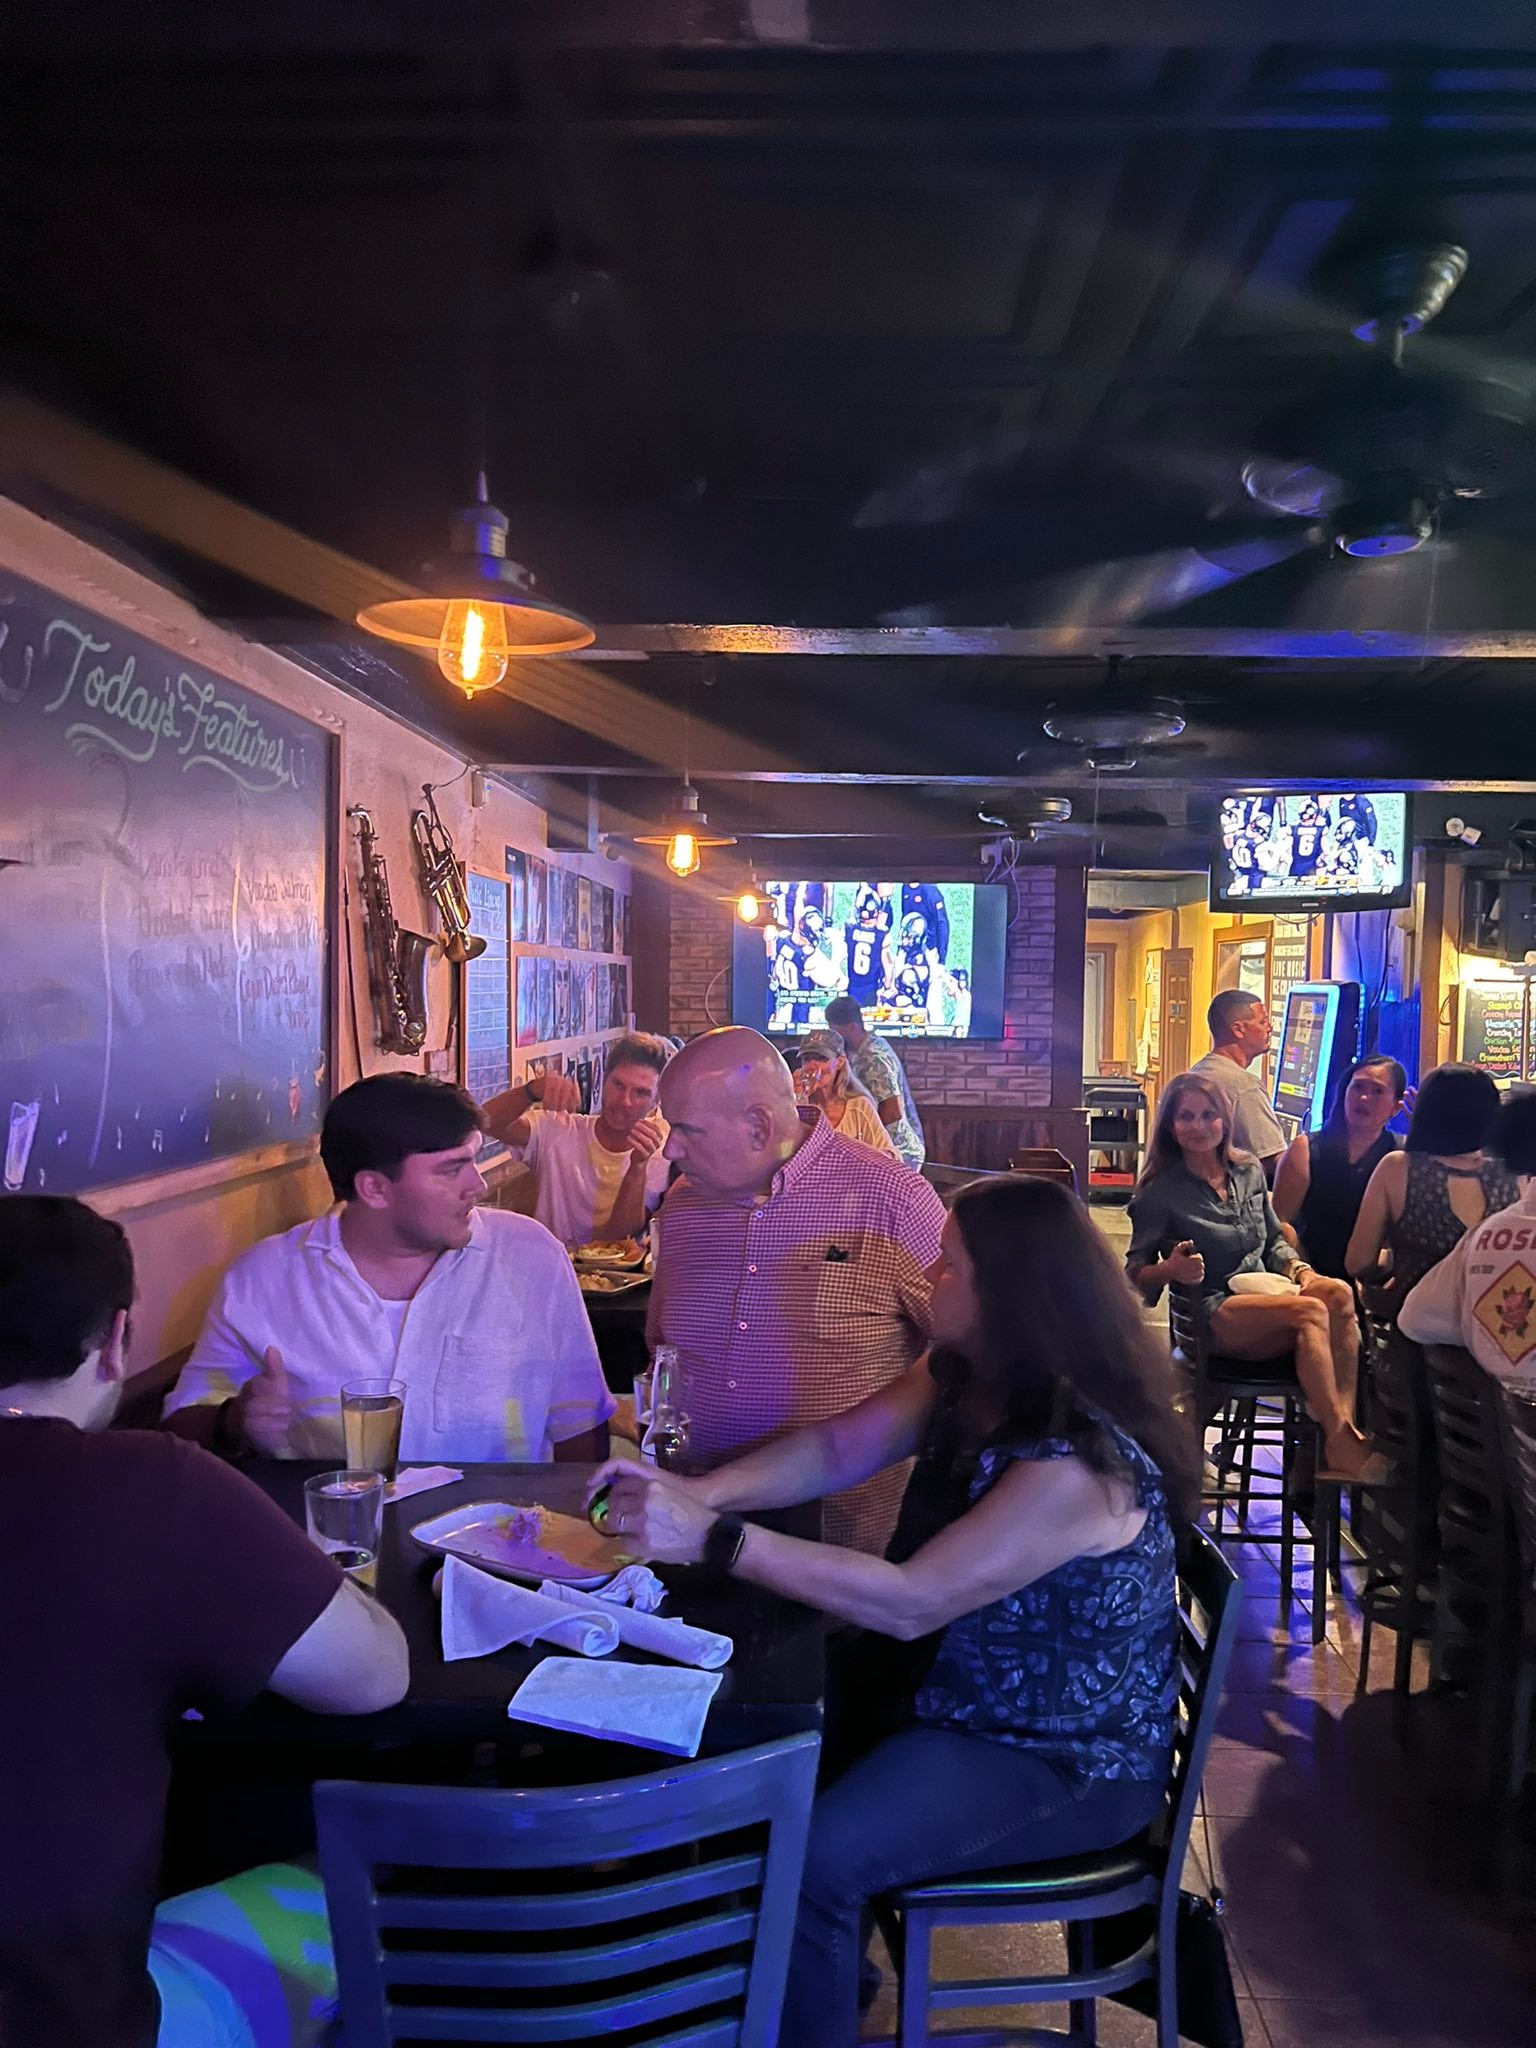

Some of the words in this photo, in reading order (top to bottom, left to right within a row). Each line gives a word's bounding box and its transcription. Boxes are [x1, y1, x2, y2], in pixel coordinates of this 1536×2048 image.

[44, 619, 182, 763] Today's
[177, 672, 290, 793] Features
[854, 941, 871, 976] 6
[1475, 1229, 1536, 1251] ROS
